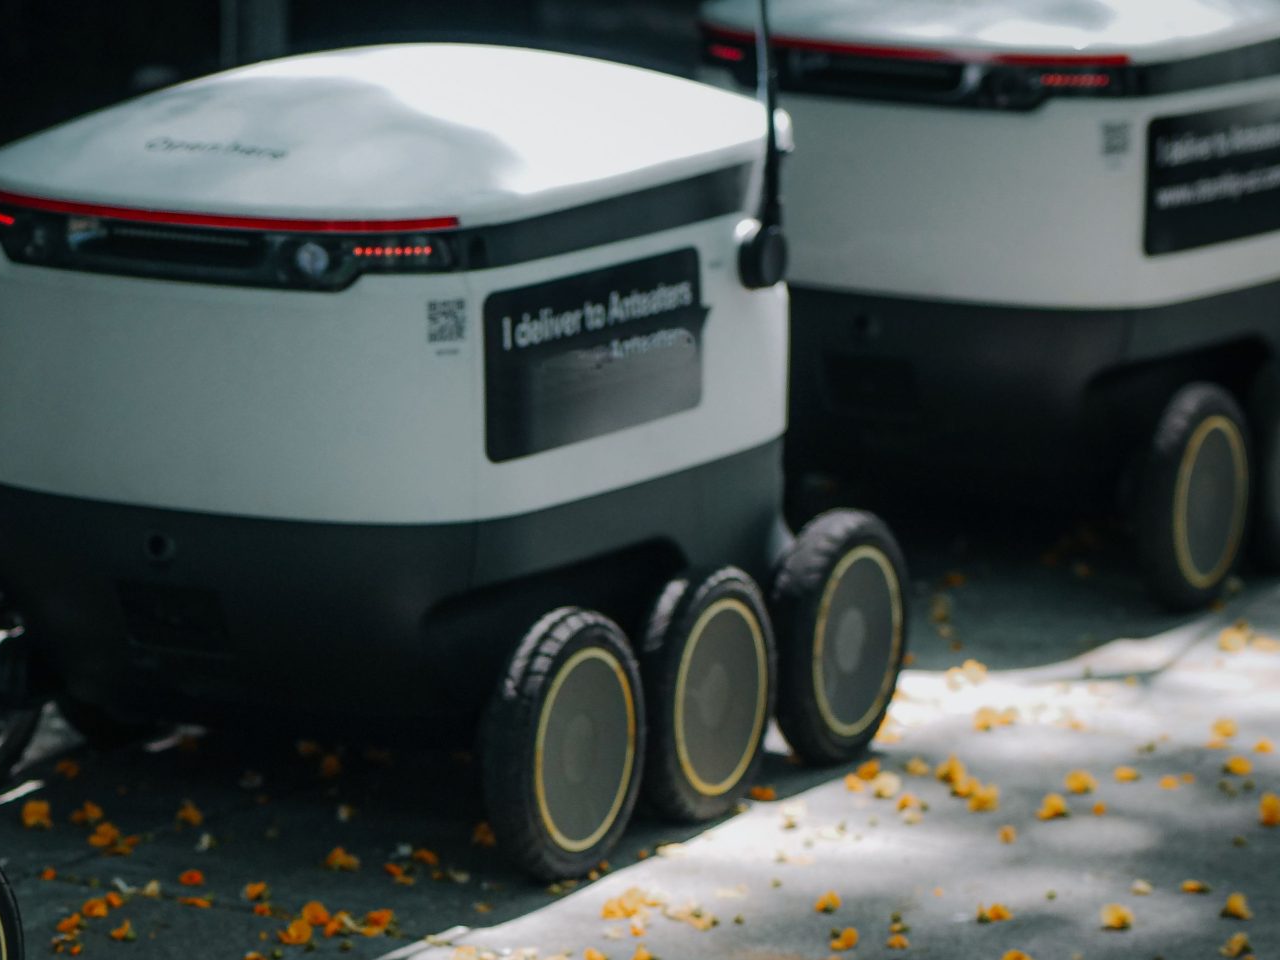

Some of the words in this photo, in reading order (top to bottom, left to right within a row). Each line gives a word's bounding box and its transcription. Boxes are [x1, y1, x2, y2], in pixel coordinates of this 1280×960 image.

[502, 316, 512, 351] I
[515, 306, 583, 349] deliver
[584, 300, 606, 331] to
